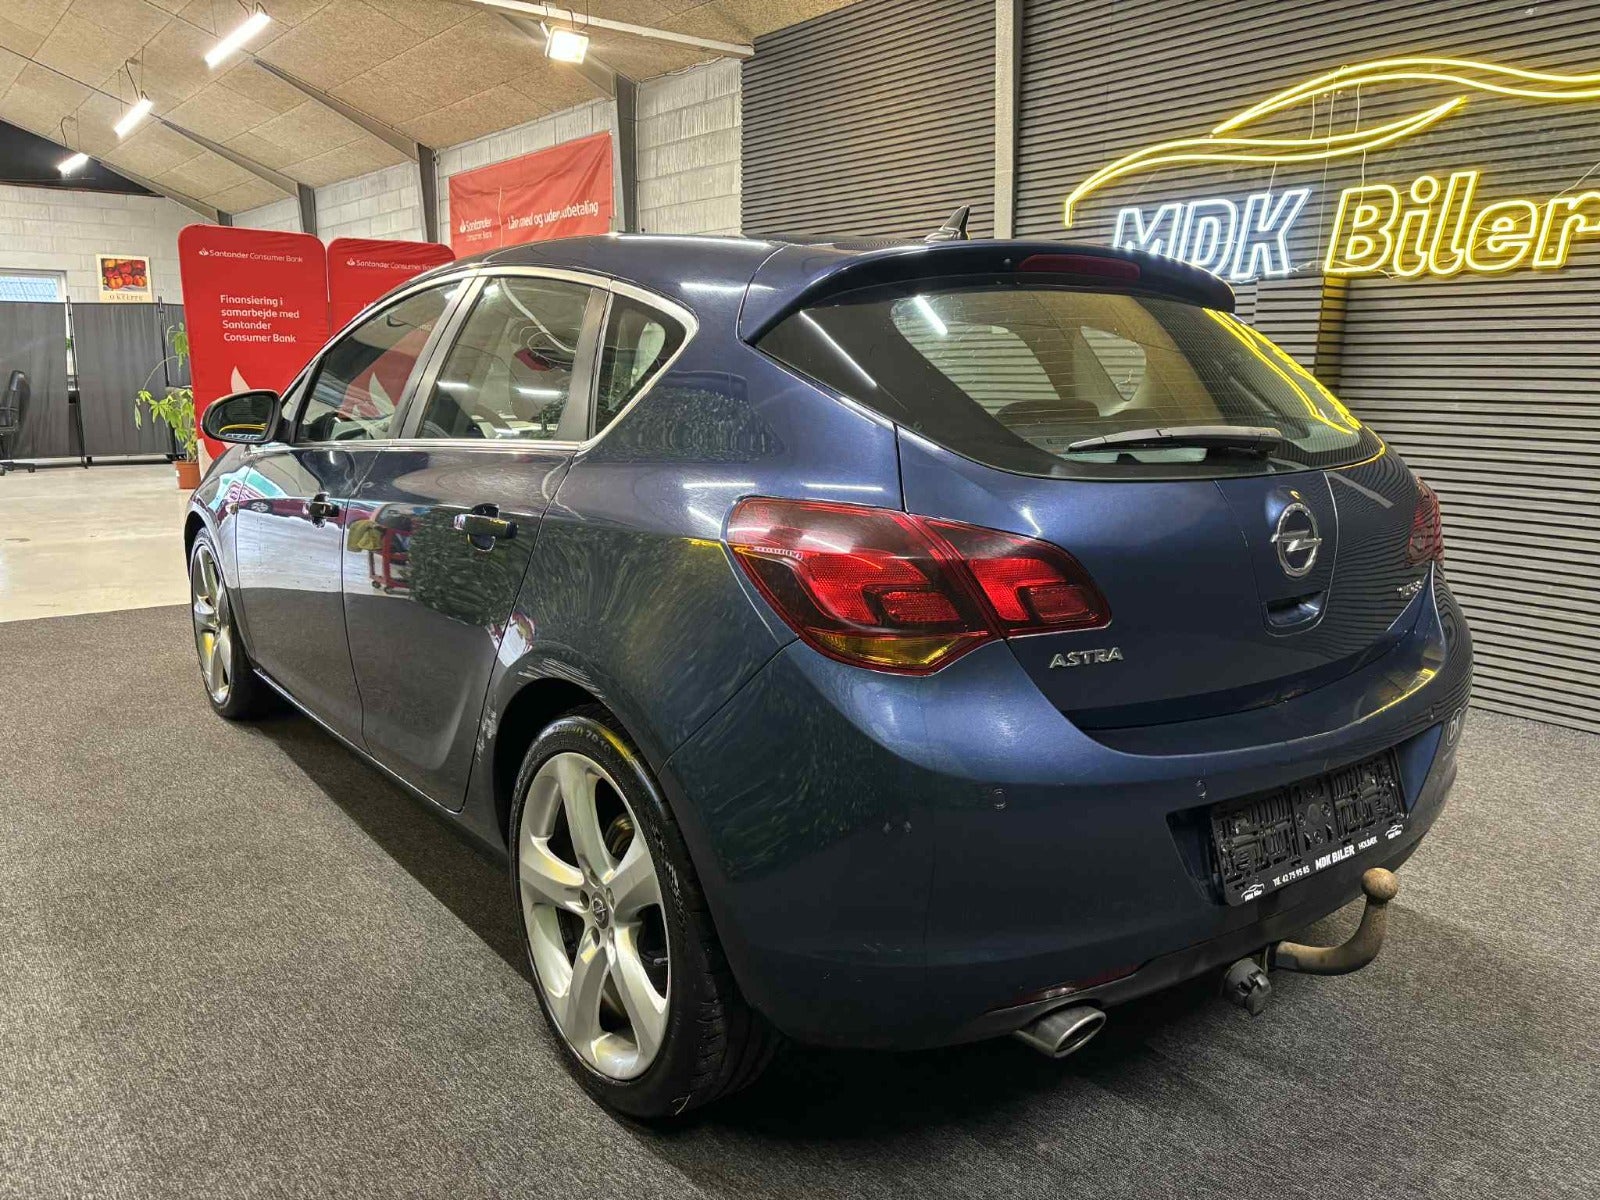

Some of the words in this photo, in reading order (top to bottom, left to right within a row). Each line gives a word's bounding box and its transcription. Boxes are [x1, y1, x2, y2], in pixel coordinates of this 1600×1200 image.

[534, 213, 544, 228] og
[1112, 188, 1311, 279] MDK
[1322, 169, 1600, 277] Biler
[209, 249, 248, 259] Santander
[249, 252, 285, 262] Consumer
[286, 255, 304, 263] Bank
[356, 259, 390, 269] Santander
[390, 261, 421, 271] Consumer
[220, 295, 278, 307] Finansiering
[279, 297, 284, 306] i
[221, 308, 278, 320] samarbejde
[279, 310, 300, 319] med
[222, 320, 272, 330] Santander
[223, 332, 272, 343] Consumer
[272, 333, 297, 343] Bank
[1048, 647, 1124, 669] ASTRA
[1315, 854, 1331, 870] MDK
[1331, 844, 1355, 863] BILER
